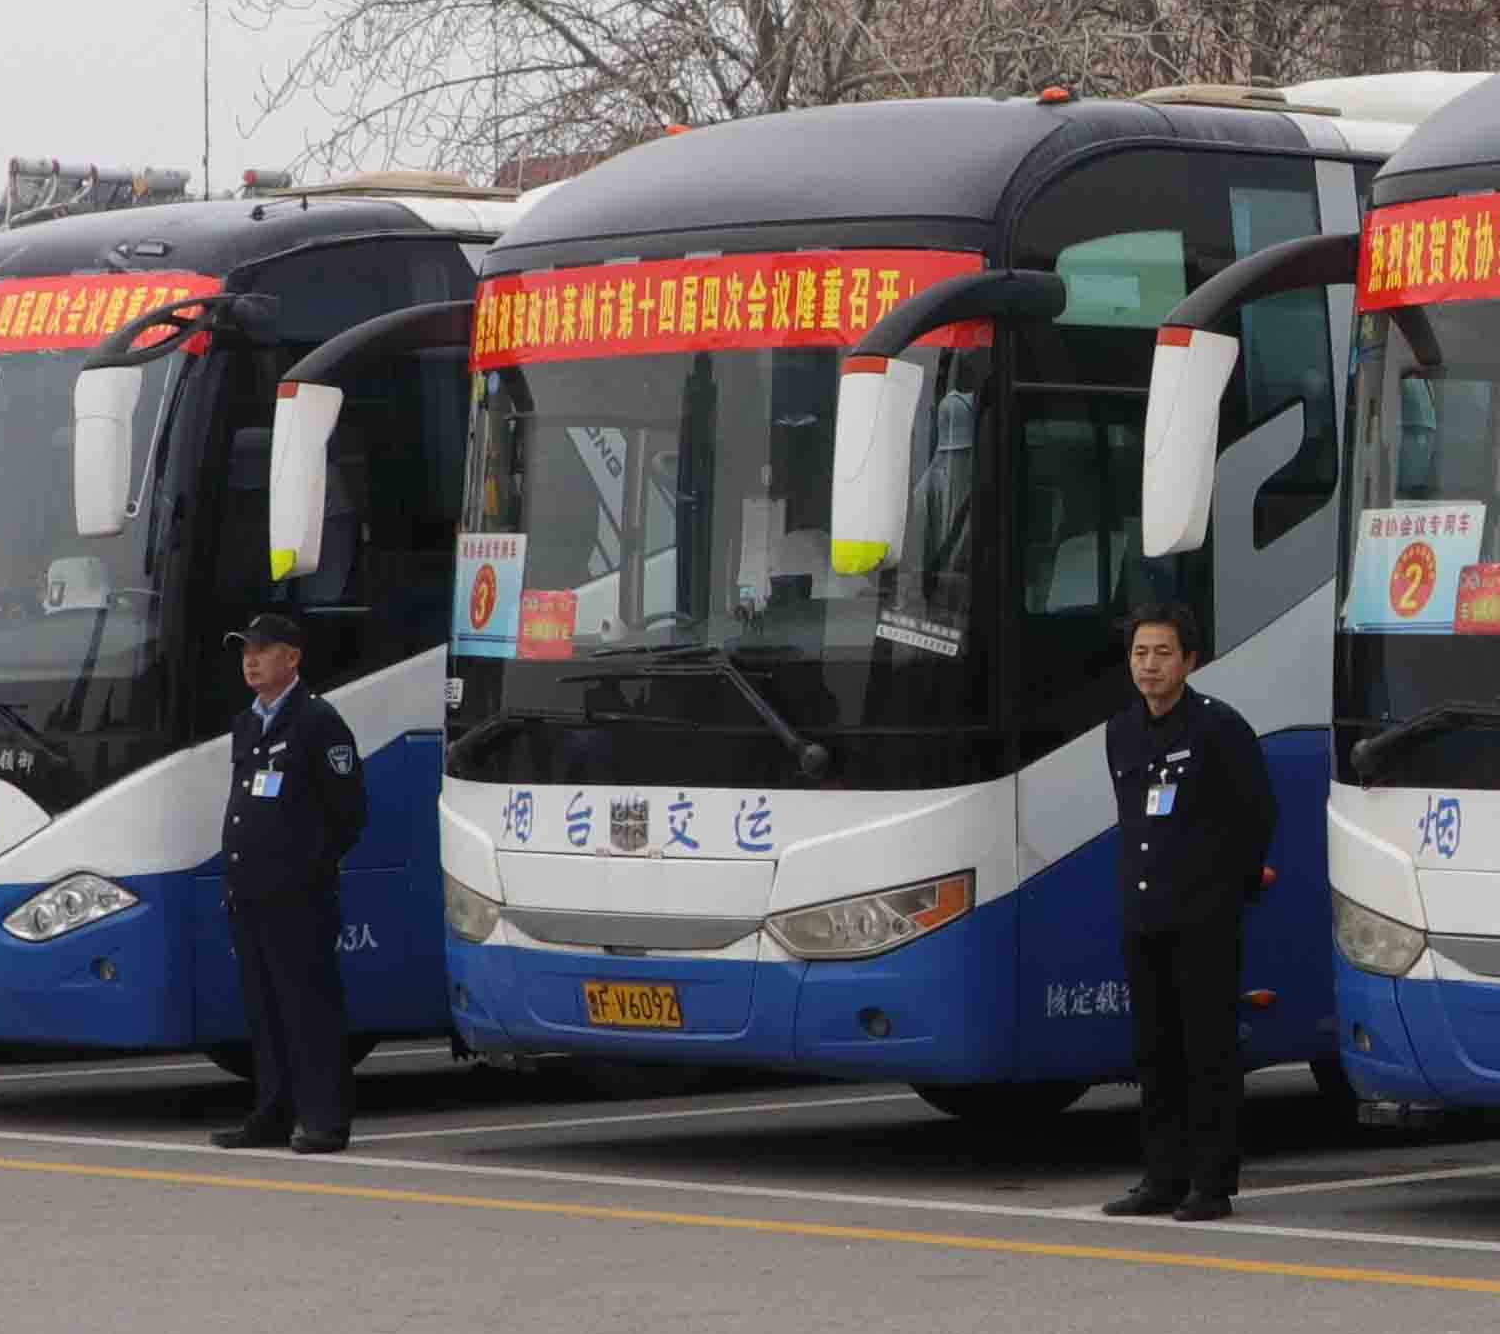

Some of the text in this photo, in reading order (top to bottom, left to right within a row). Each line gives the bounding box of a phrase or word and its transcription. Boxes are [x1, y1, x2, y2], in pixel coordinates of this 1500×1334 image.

[1398, 563, 1424, 609] 2
[502, 786, 774, 852] 烟台交运
